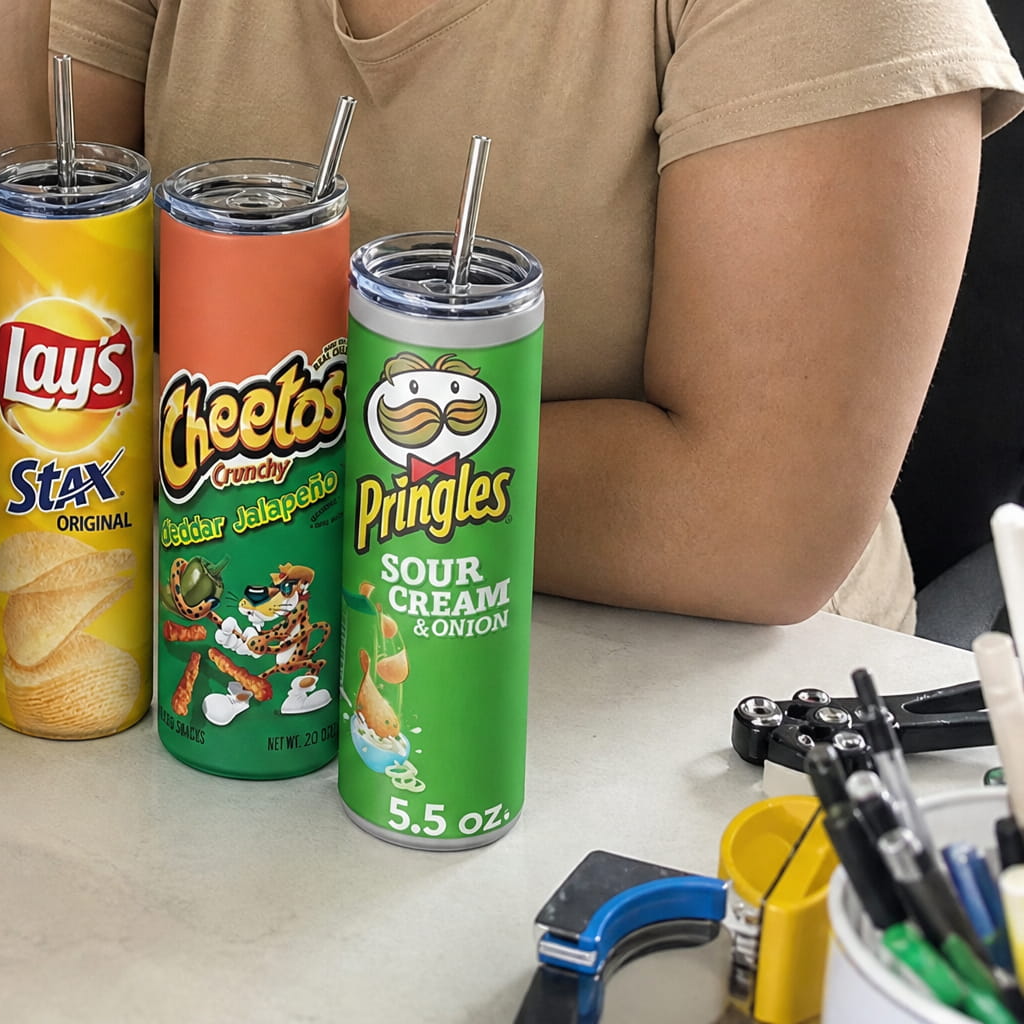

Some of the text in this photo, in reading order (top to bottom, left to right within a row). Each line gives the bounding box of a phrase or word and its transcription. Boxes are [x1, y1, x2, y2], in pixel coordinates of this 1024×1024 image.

[3, 326, 126, 410] Lay's
[163, 362, 344, 489] Cheetos
[212, 457, 291, 487] Crunchy
[56, 512, 133, 532] ORIGINAL
[232, 470, 338, 534] Jalapeño
[356, 460, 513, 553] Pringles
[381, 553, 483, 587] SOUR
[388, 578, 510, 617] CREAM
[388, 796, 447, 836] 5.5
